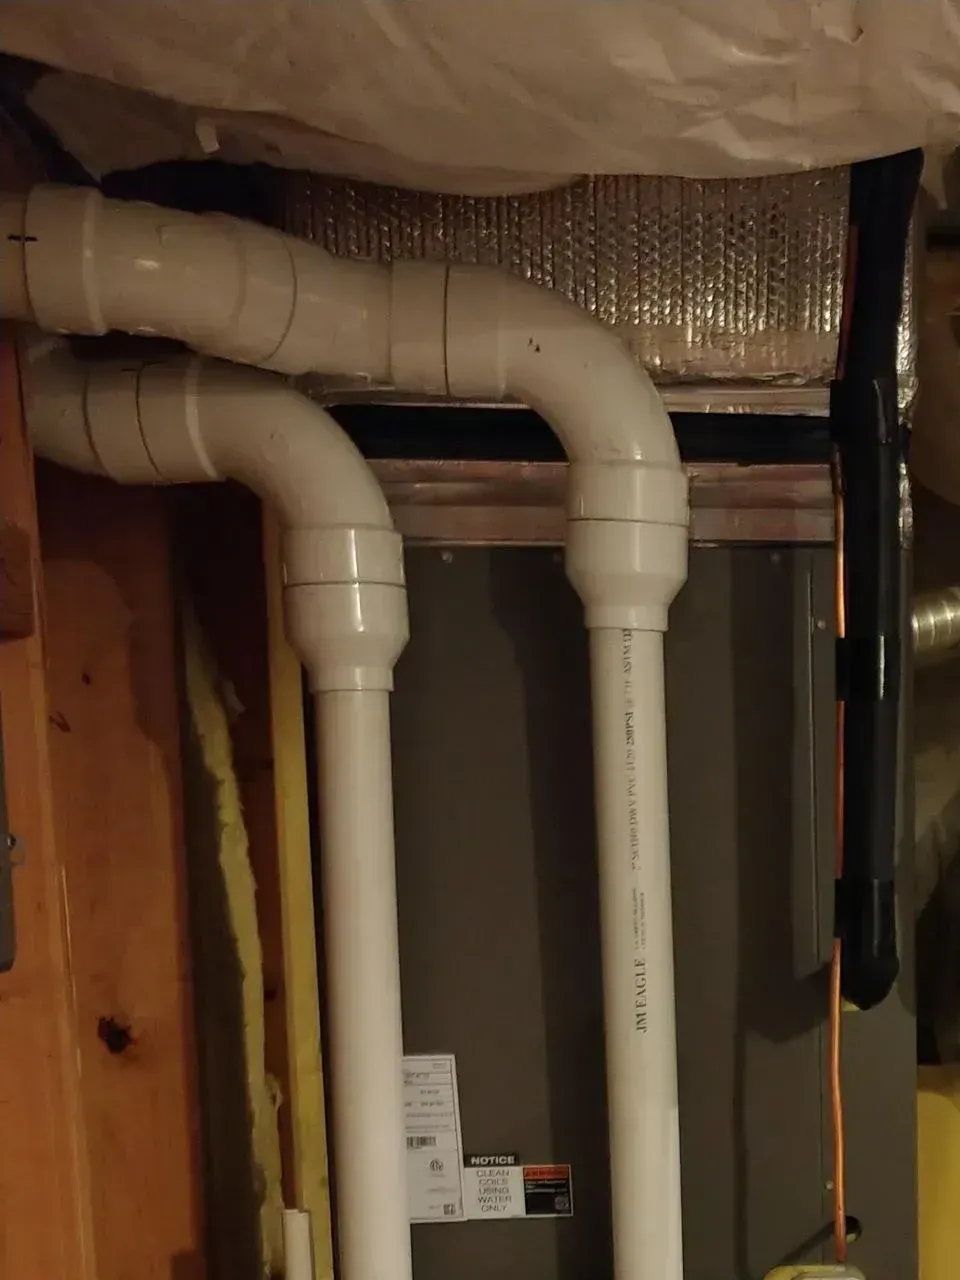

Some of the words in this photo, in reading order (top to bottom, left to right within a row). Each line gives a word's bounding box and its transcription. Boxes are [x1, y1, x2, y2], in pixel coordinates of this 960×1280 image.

[634, 959, 647, 1008] EAGLE
[635, 1012, 647, 1034] JM
[471, 1155, 515, 1165] NOTICE
[476, 1169, 510, 1178] CLEAN
[479, 1178, 509, 1186] COILS
[479, 1187, 510, 1195] USING
[478, 1195, 512, 1204] WATER
[480, 1204, 507, 1213] ONLY
